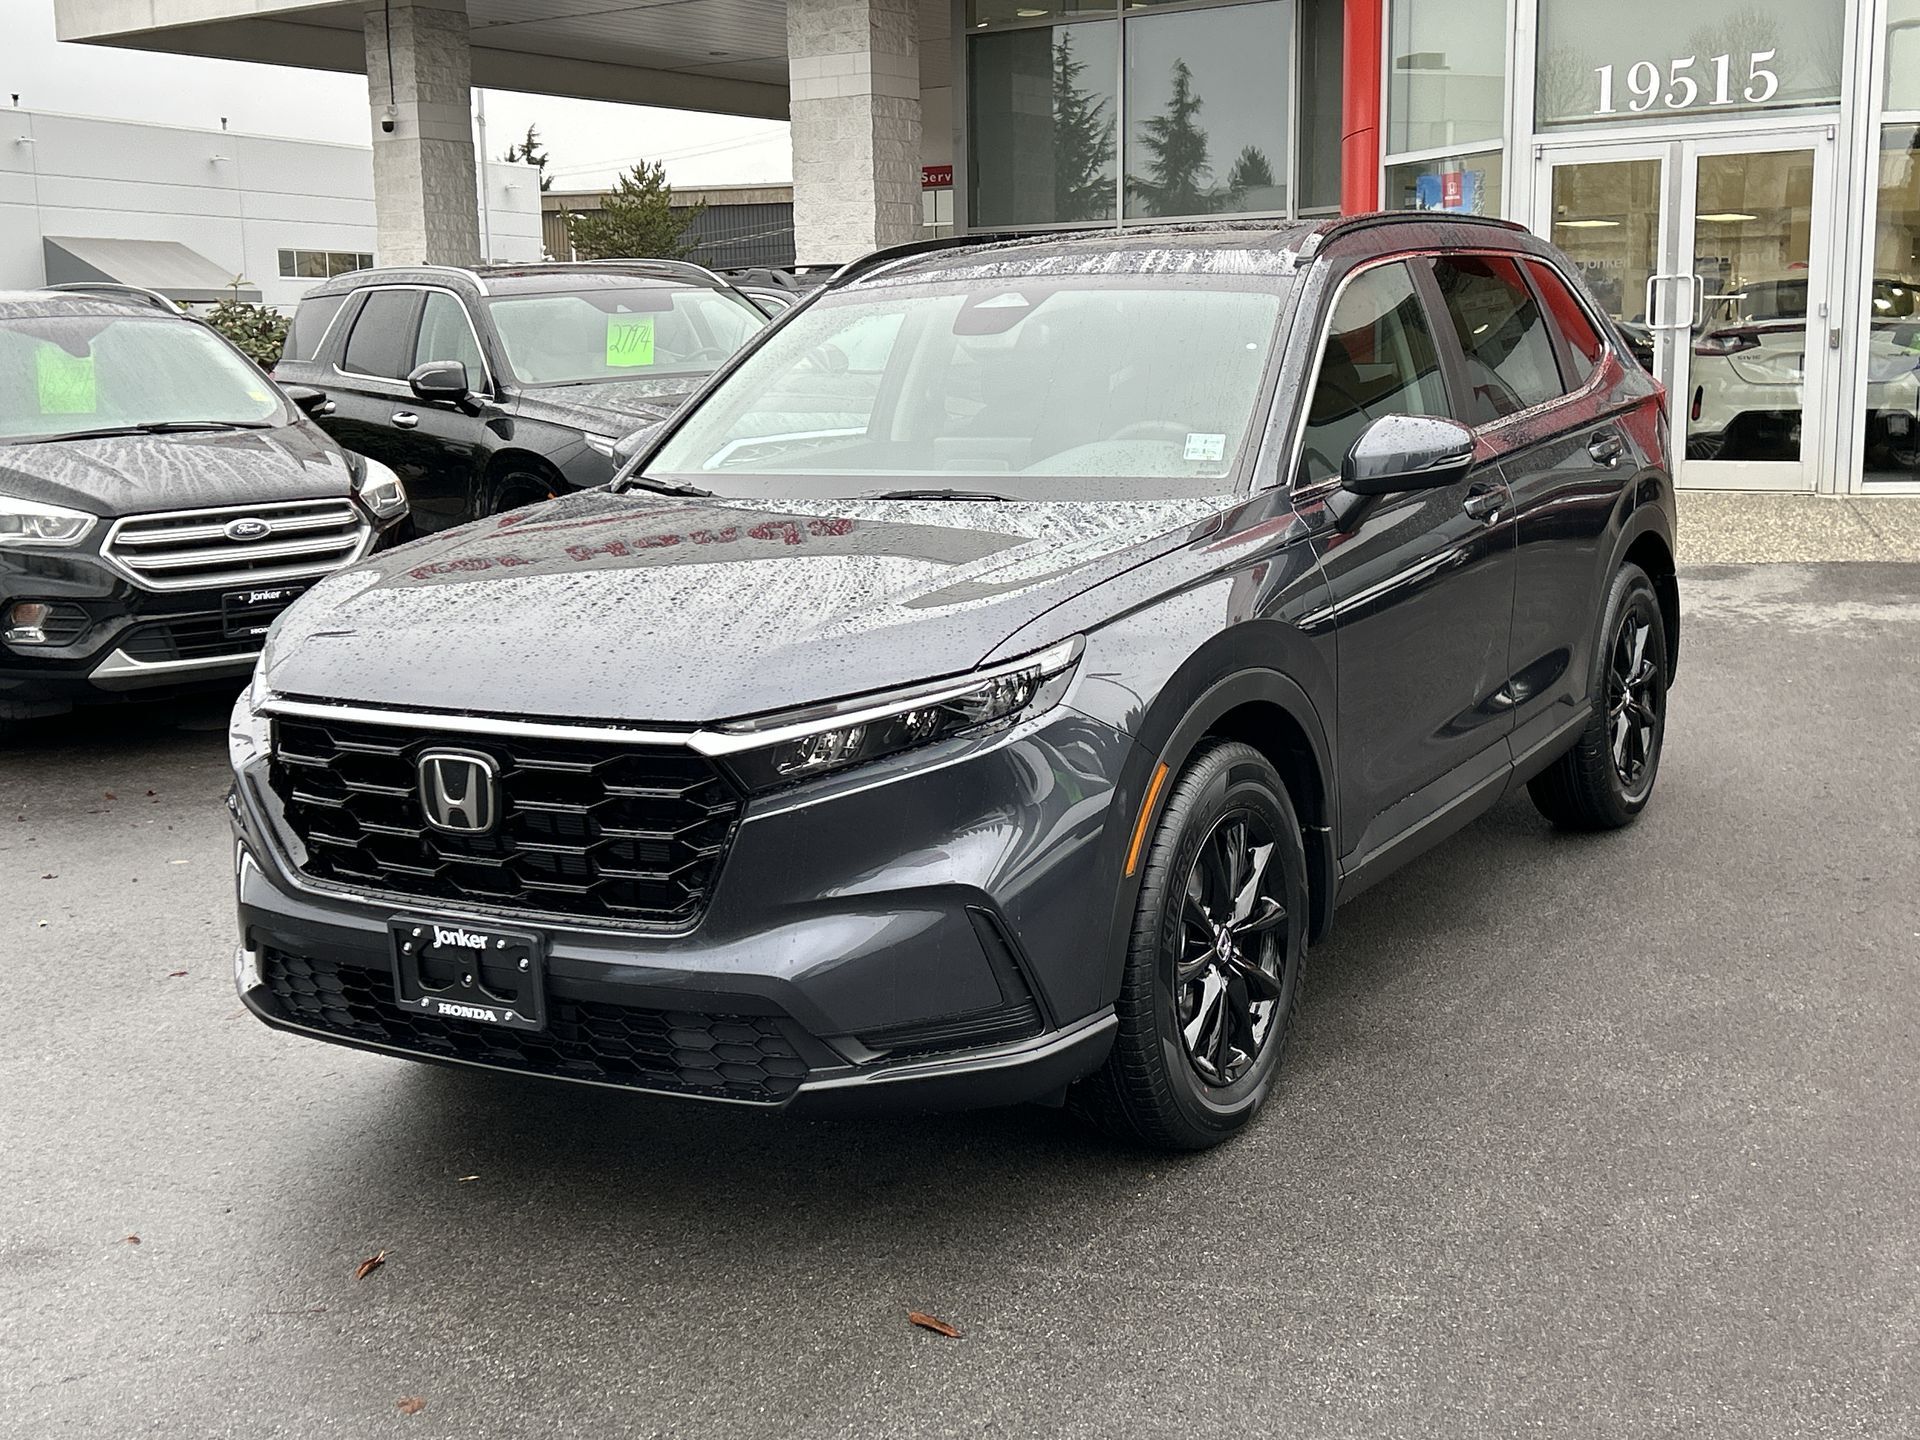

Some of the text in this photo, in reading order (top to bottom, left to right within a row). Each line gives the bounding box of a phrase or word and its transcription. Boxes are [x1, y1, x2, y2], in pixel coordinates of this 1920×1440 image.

[1593, 47, 1779, 114] 19515
[921, 172, 951, 182] Serv
[248, 590, 281, 604] Jonker
[433, 925, 488, 950] Jonker
[438, 1003, 497, 1022] HONDA
